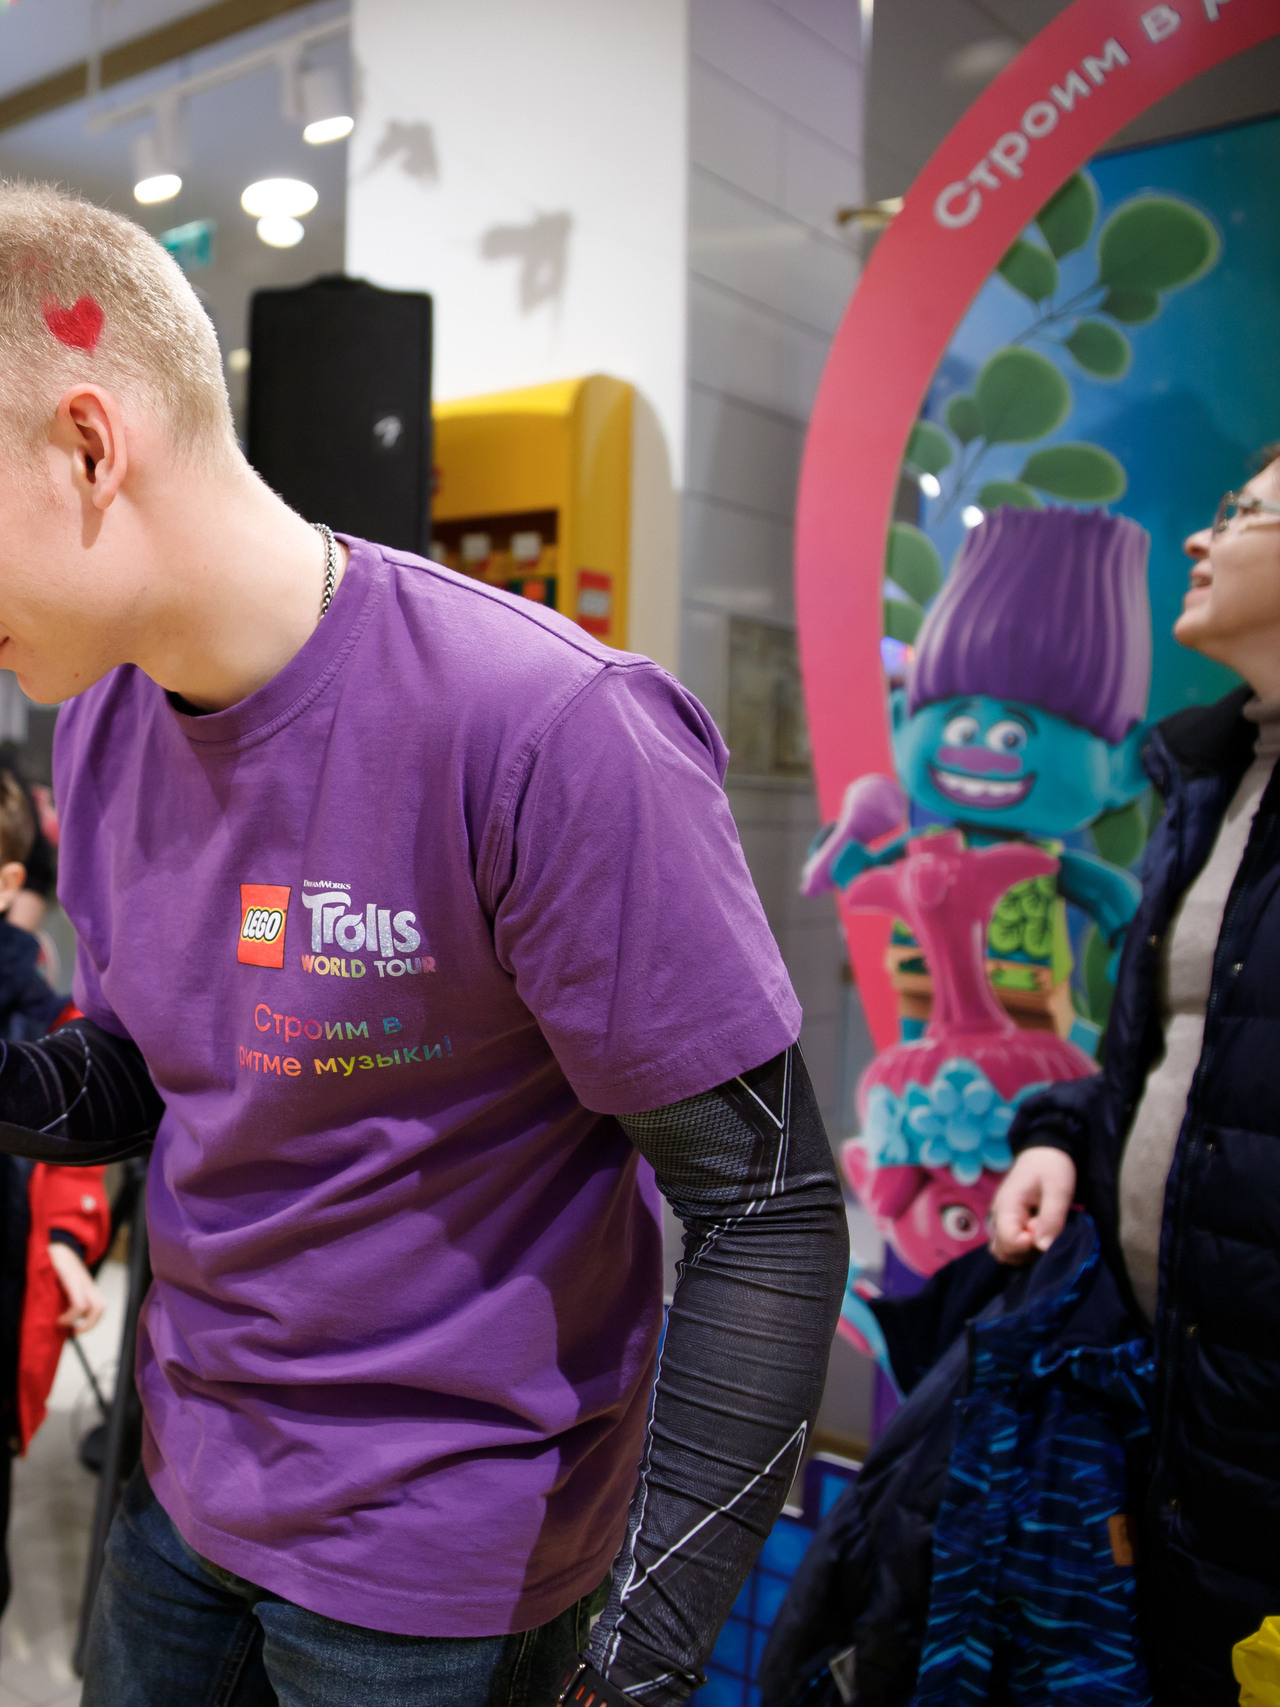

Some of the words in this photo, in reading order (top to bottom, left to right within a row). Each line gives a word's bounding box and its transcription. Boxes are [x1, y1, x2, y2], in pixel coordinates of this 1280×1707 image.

[934, 37, 1131, 229] Строим
[242, 907, 284, 942] LEGO
[301, 954, 366, 978] WORLD
[373, 956, 436, 978] TOUR
[254, 1003, 370, 1043] Строим
[382, 1016, 403, 1035] в
[238, 1045, 302, 1077] ритме
[313, 1036, 454, 1077] музыки!
